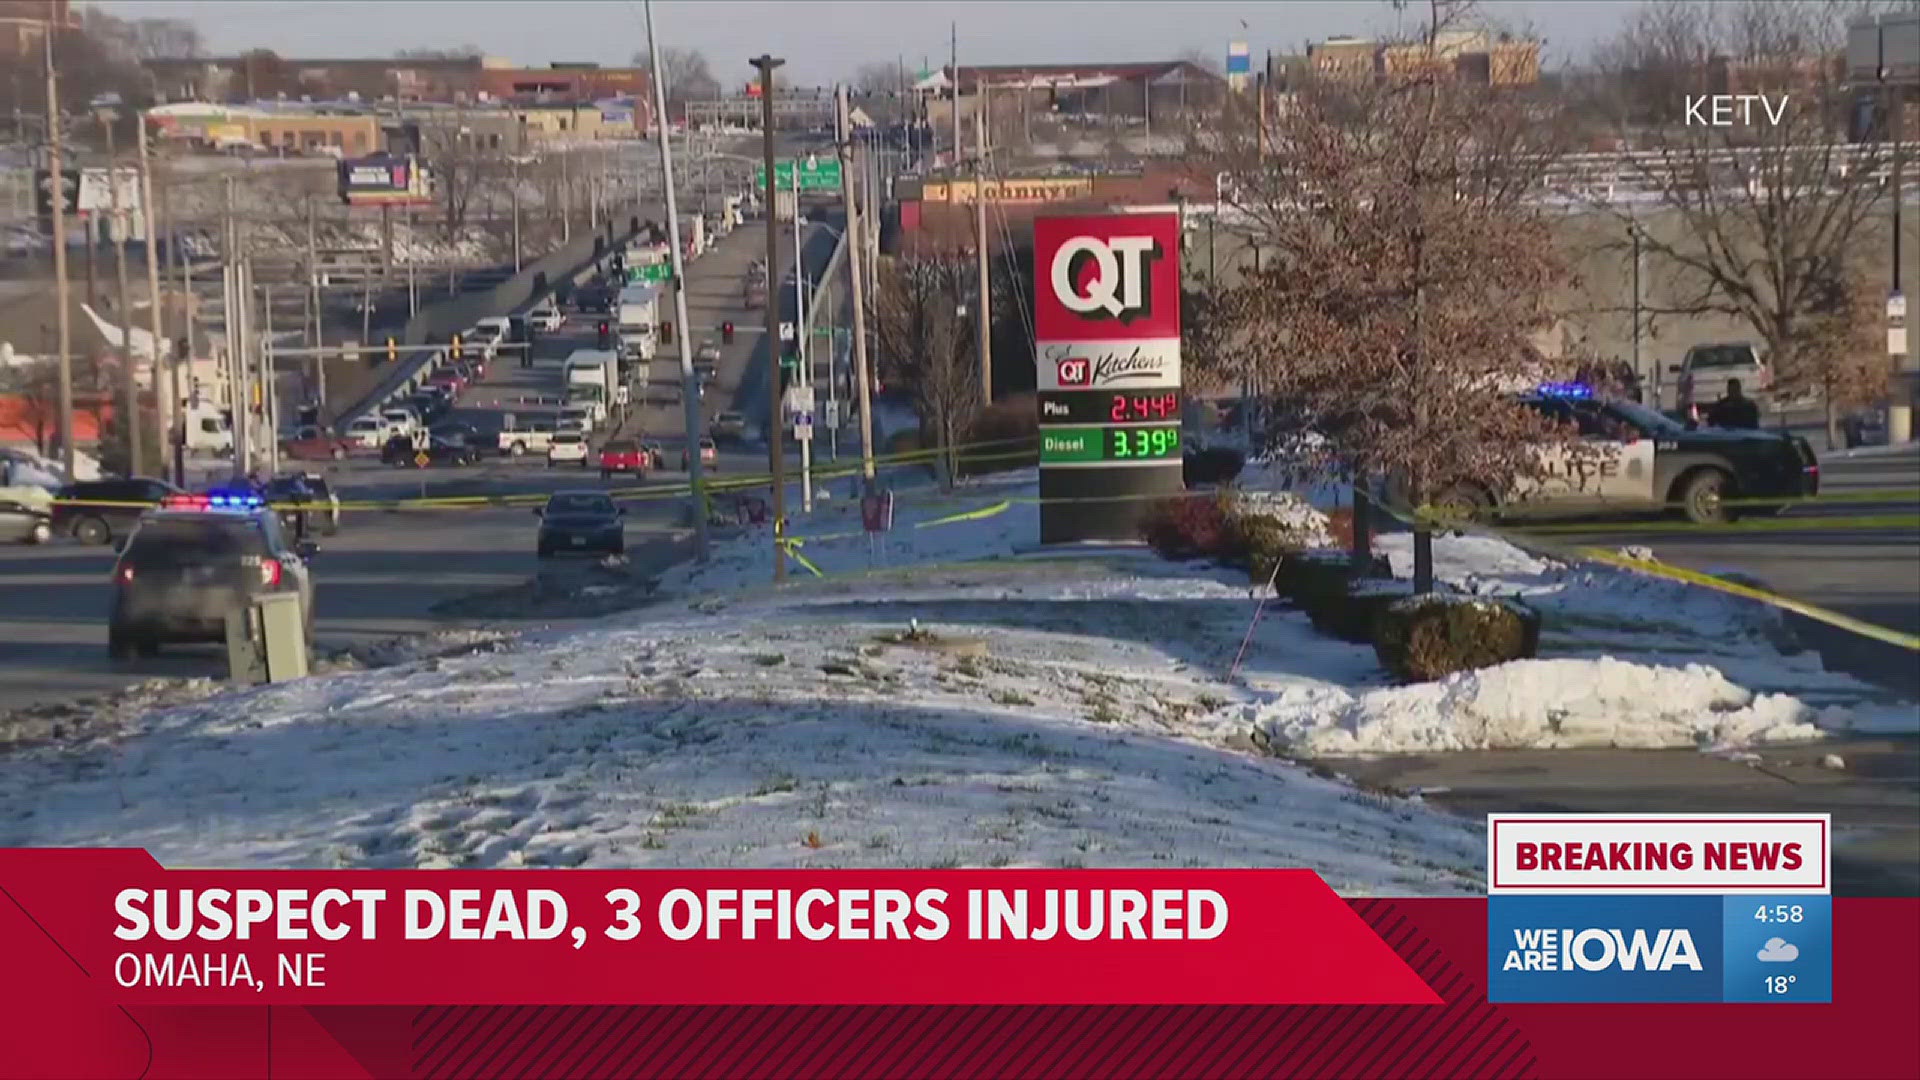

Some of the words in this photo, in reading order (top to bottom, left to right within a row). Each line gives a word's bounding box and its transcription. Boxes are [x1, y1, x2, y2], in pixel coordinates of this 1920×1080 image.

[974, 178, 1078, 199] ohnny's
[1051, 236, 1155, 318] QT
[1059, 361, 1086, 383] QT
[1092, 346, 1164, 385] Kitchens
[1044, 401, 1069, 416] Plus
[1112, 393, 1177, 421] 2.449
[1045, 437, 1084, 452] Diesel
[1114, 429, 1178, 457] 3.399
[1530, 459, 1619, 477] LICE
